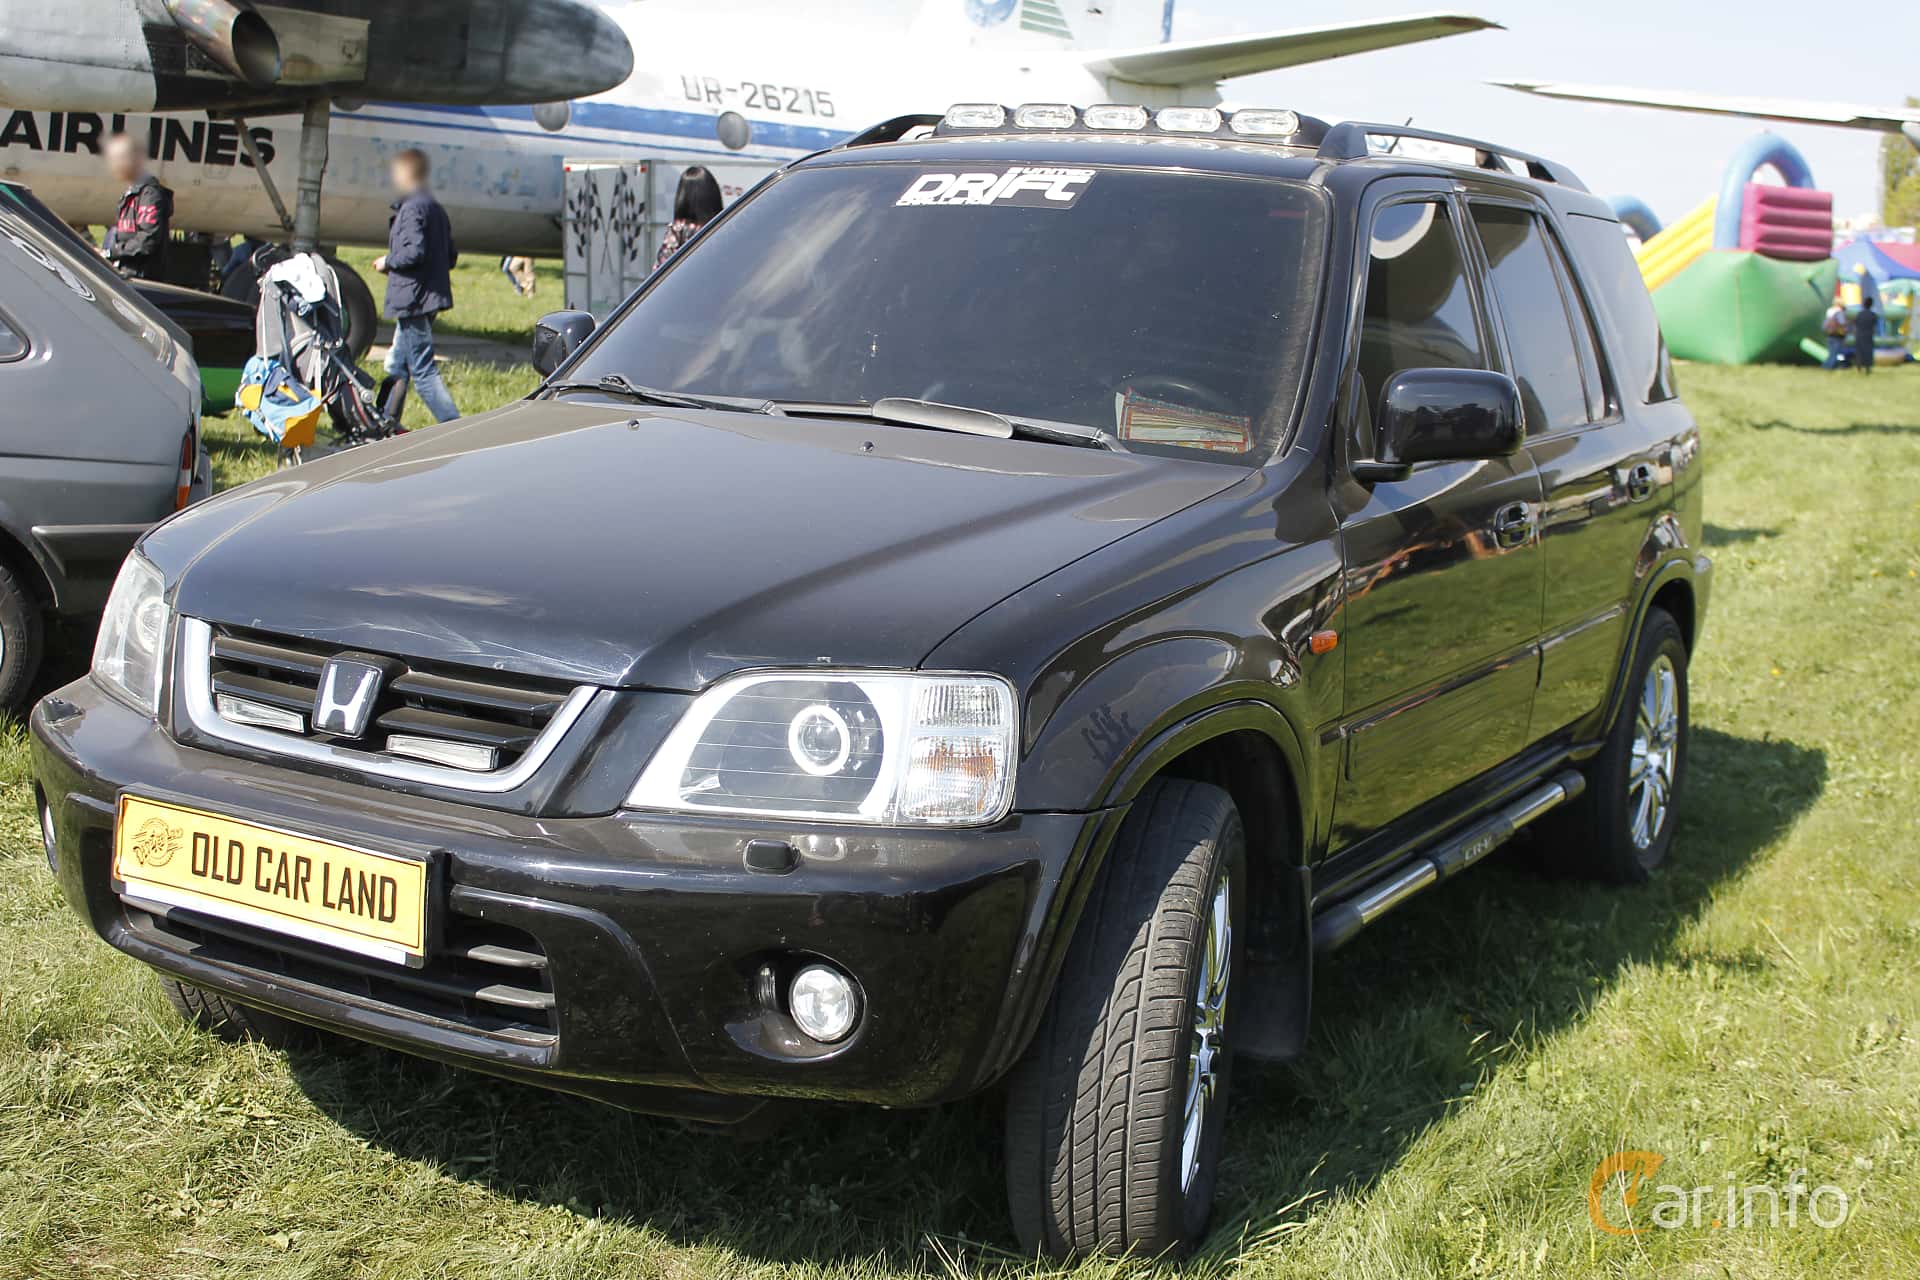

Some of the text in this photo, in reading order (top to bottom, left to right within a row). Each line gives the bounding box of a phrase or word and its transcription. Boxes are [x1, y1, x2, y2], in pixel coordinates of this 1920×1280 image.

[681, 75, 835, 117] UR-26215
[191, 831, 245, 885] OLD
[255, 846, 311, 903] CAR
[322, 862, 397, 923] LAND
